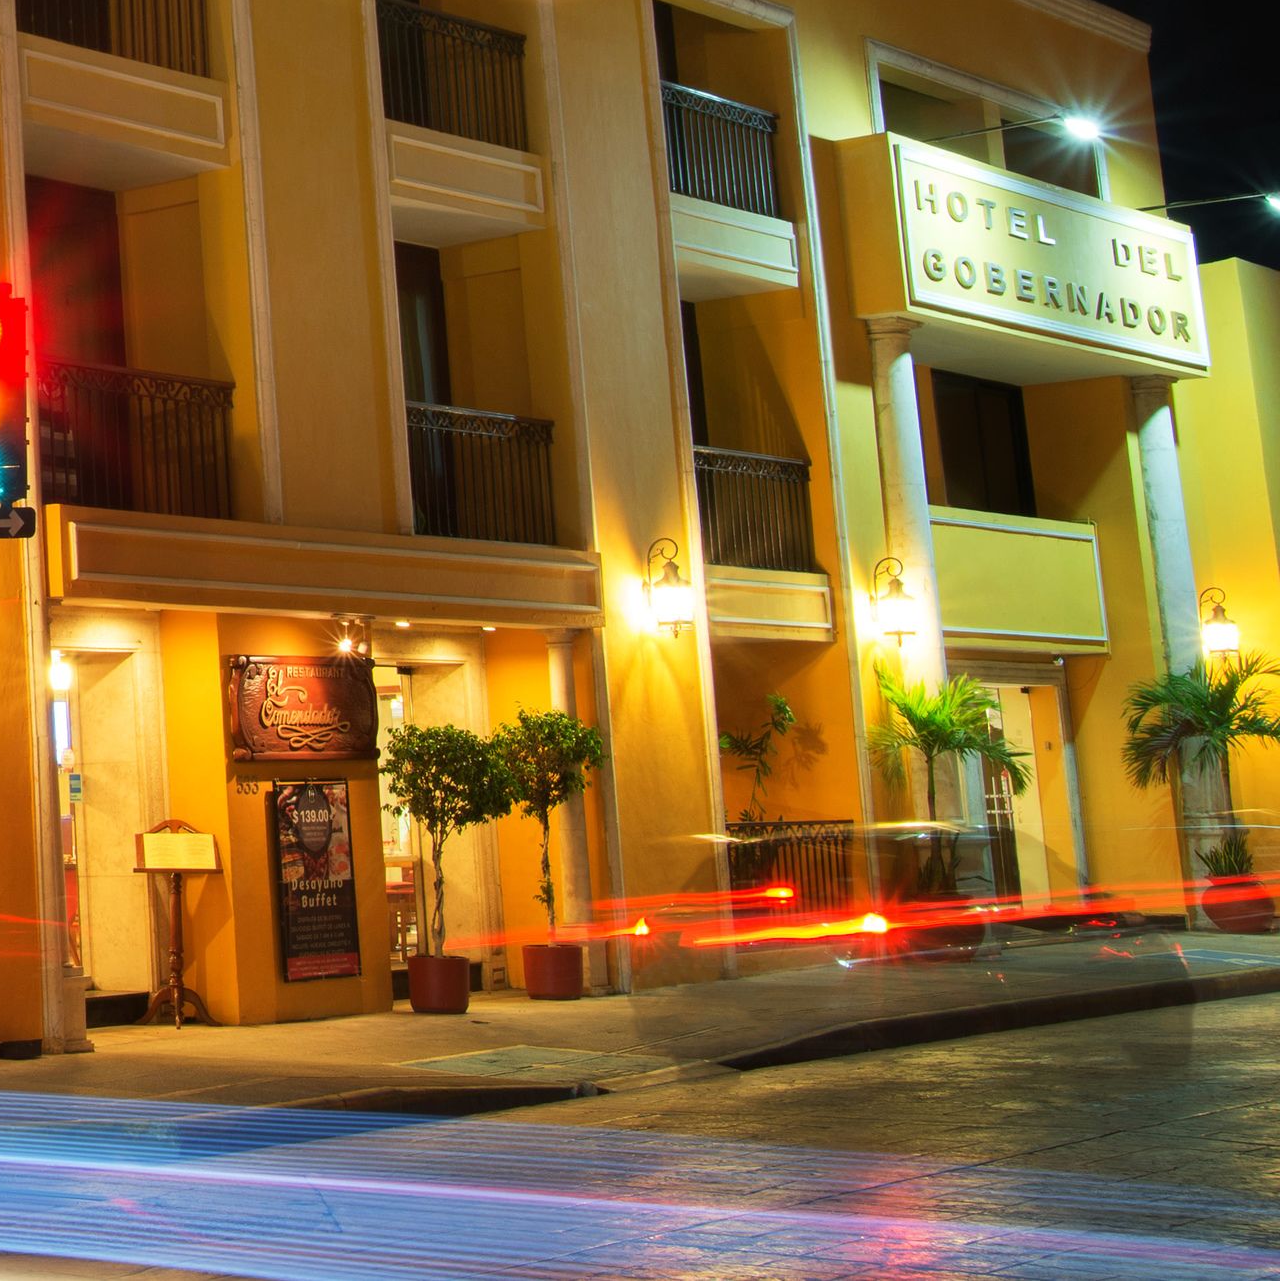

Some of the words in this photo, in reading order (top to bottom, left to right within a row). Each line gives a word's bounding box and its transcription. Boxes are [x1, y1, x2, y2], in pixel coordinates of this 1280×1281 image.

[913, 179, 1056, 246] HOTEL
[1112, 237, 1183, 282] DEL
[922, 248, 1191, 343] GOBERNADOR
[291, 878, 344, 893] Desayuno
[301, 892, 338, 909] Buffet
